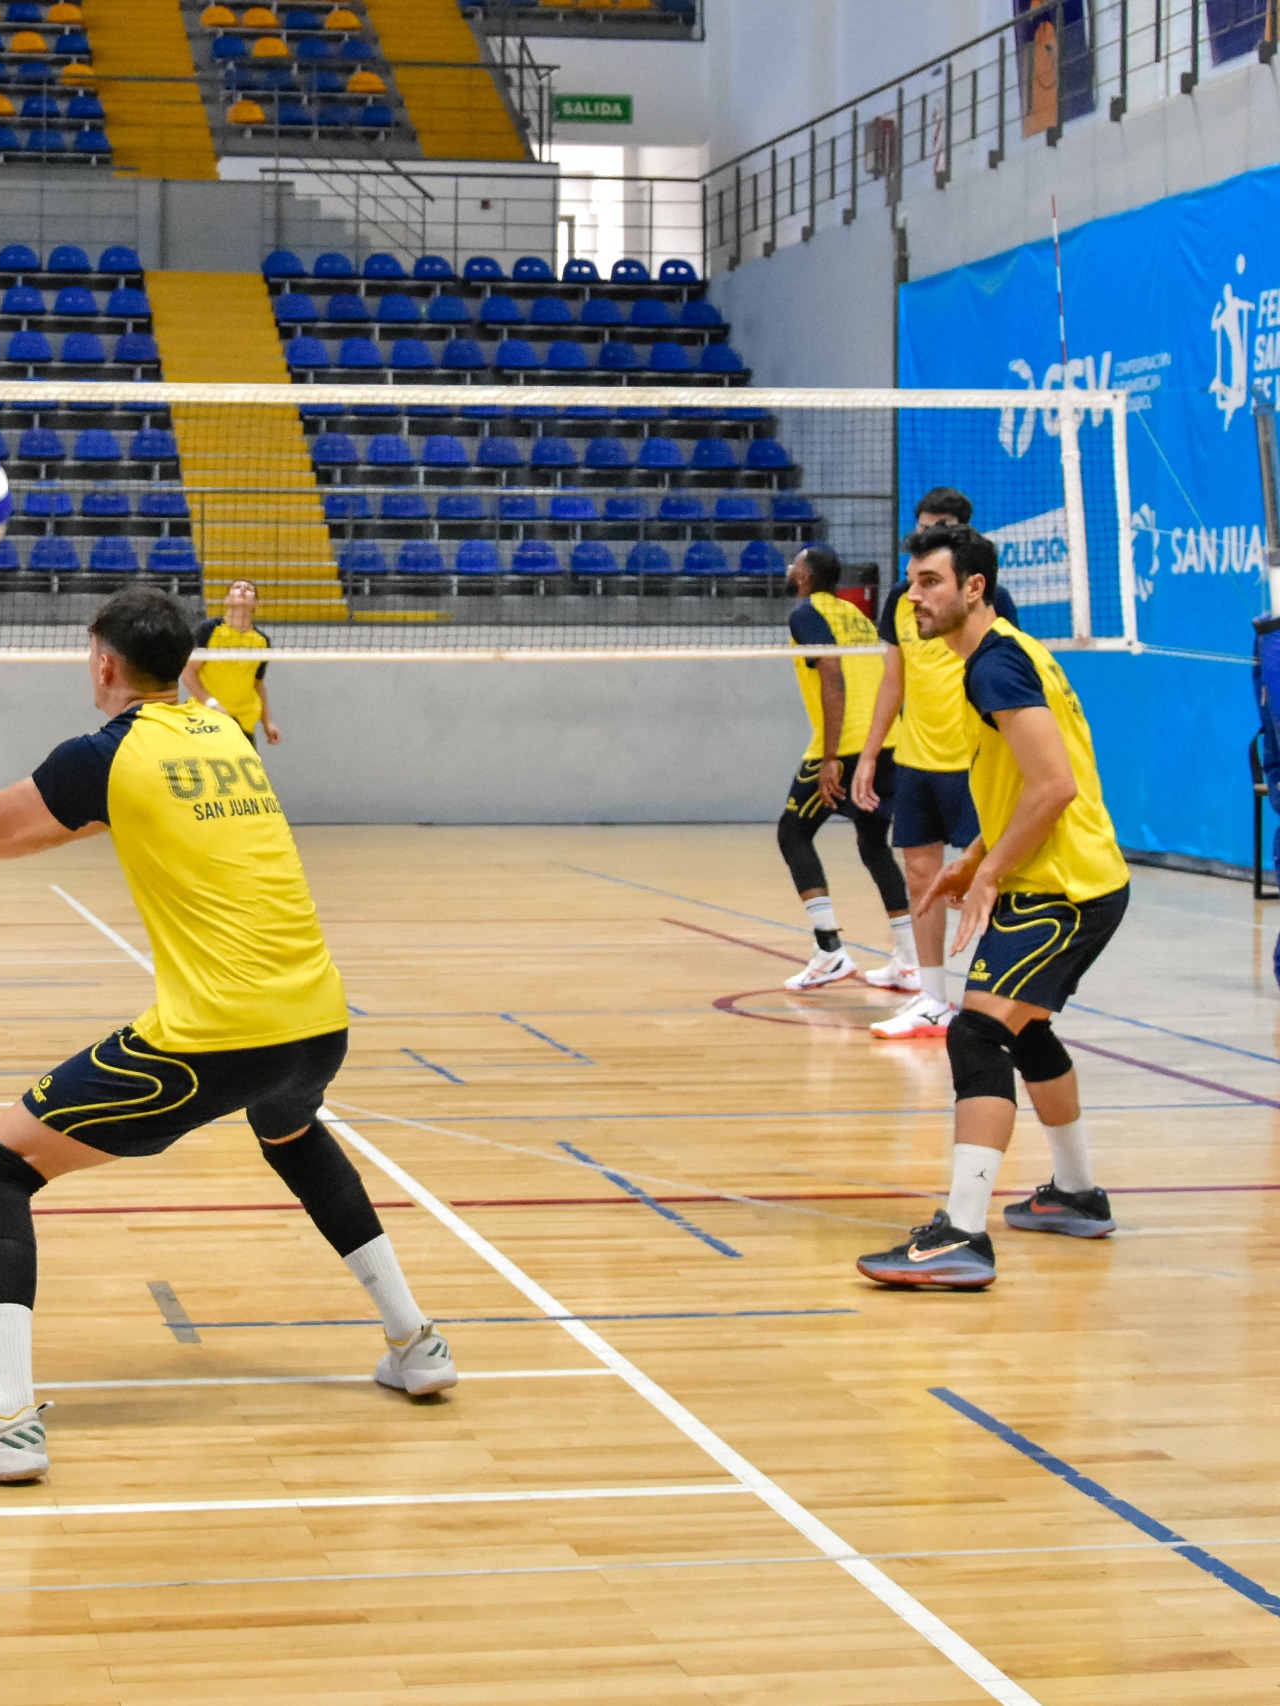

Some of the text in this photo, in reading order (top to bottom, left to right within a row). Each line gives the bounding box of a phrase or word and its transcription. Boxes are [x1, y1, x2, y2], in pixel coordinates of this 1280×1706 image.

[563, 102, 623, 115] SALIDA
[193, 801, 225, 820] SAN
[230, 798, 260, 816] JUAN
